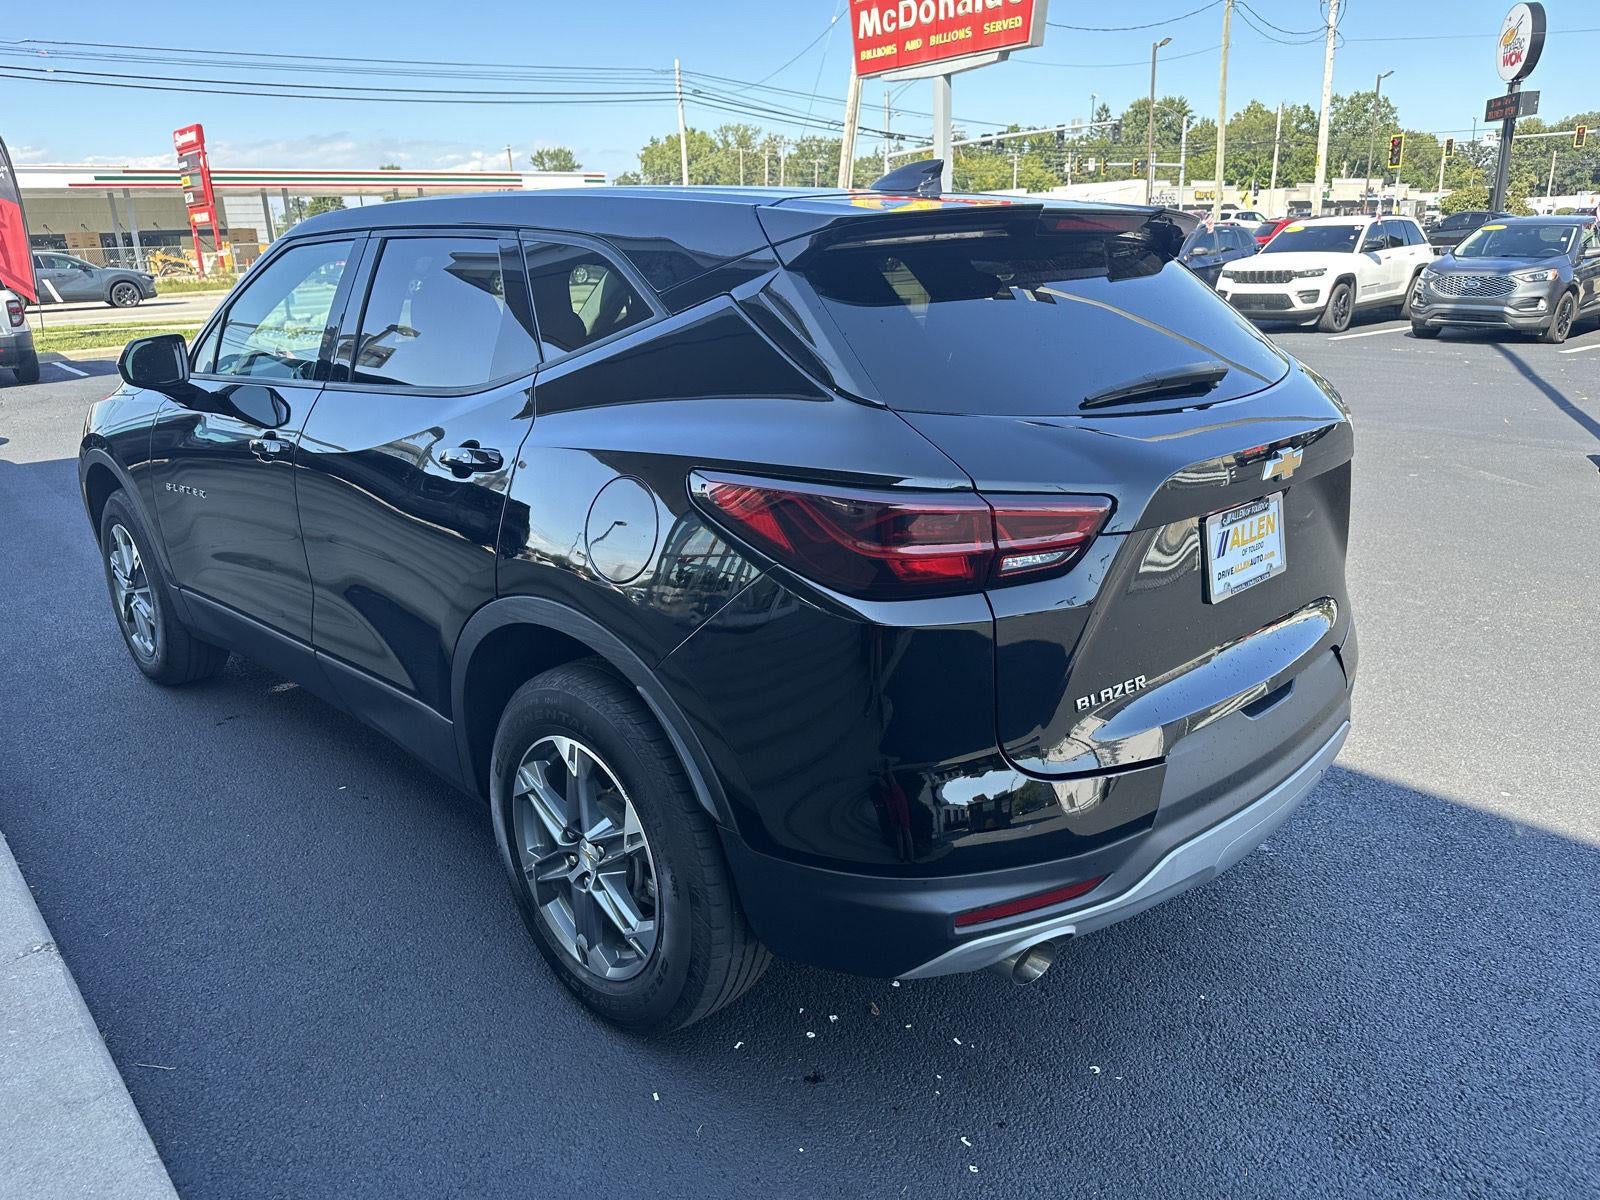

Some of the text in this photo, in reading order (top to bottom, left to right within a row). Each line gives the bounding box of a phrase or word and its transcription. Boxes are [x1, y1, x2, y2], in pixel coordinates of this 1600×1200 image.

[860, 15, 1023, 61] BILLIONS AND BILLIONS SERVED
[1502, 50, 1523, 67] WOK
[165, 482, 207, 499] BLAZER
[1229, 511, 1276, 551] ALLEN
[1241, 541, 1265, 557] OF TOLEDO
[1076, 674, 1147, 711] BLAZER
